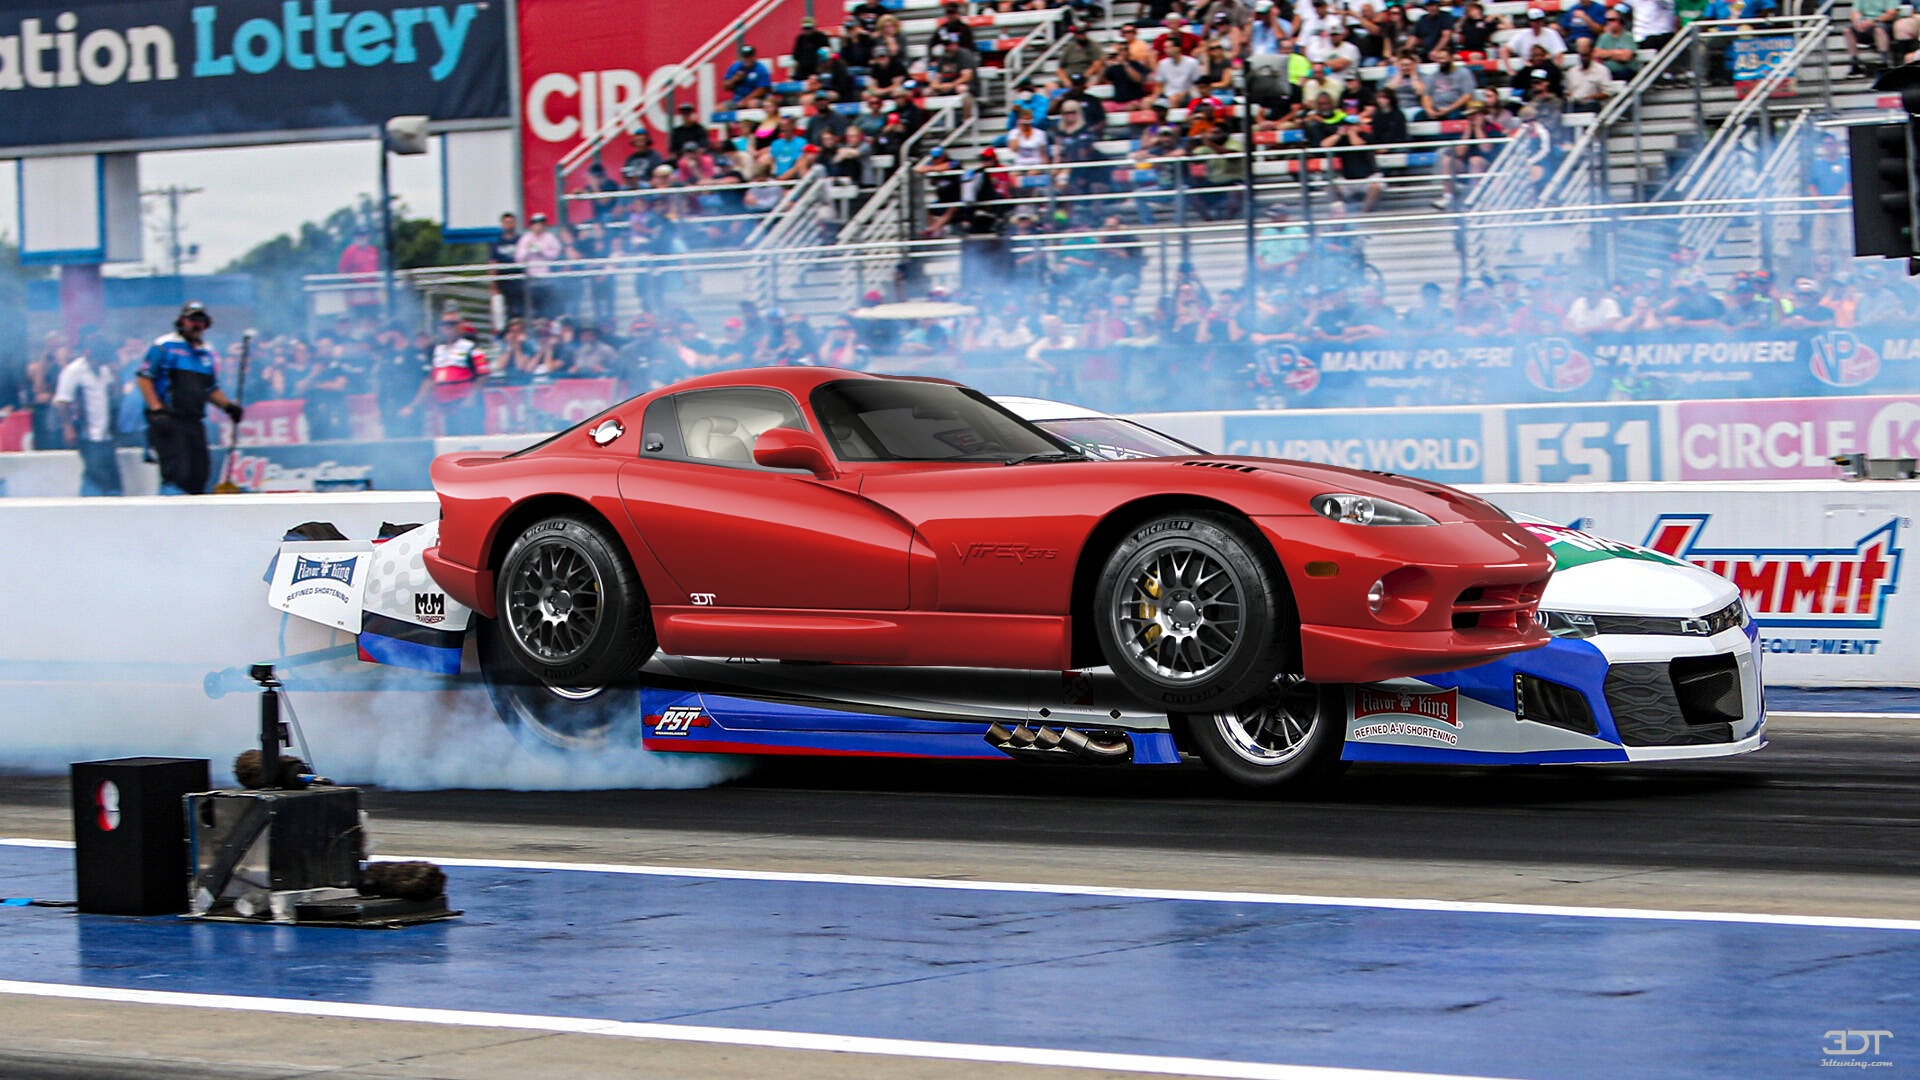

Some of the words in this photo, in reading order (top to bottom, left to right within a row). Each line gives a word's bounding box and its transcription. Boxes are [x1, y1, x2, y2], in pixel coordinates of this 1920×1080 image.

[191, 0, 478, 82] Lottery
[1692, 341, 1798, 364] POWER!
[1364, 437, 1481, 471] WORLD
[1517, 420, 1651, 482] FS1
[1682, 420, 1858, 470] CIRCLE
[526, 523, 566, 539] MICHELIN
[1137, 520, 1192, 541] MICHELIN
[1026, 549, 1058, 560] GTS
[297, 559, 321, 580] Flavor
[331, 561, 350, 583] King
[286, 587, 314, 603] REFINED
[314, 587, 350, 604] SHORTENING
[1358, 688, 1397, 713] Flavor
[1418, 695, 1449, 720] King
[655, 710, 701, 731] PST
[1354, 724, 1388, 740] REFINED
[1389, 723, 1406, 734] A-V
[1406, 725, 1457, 745] SHORTENING
